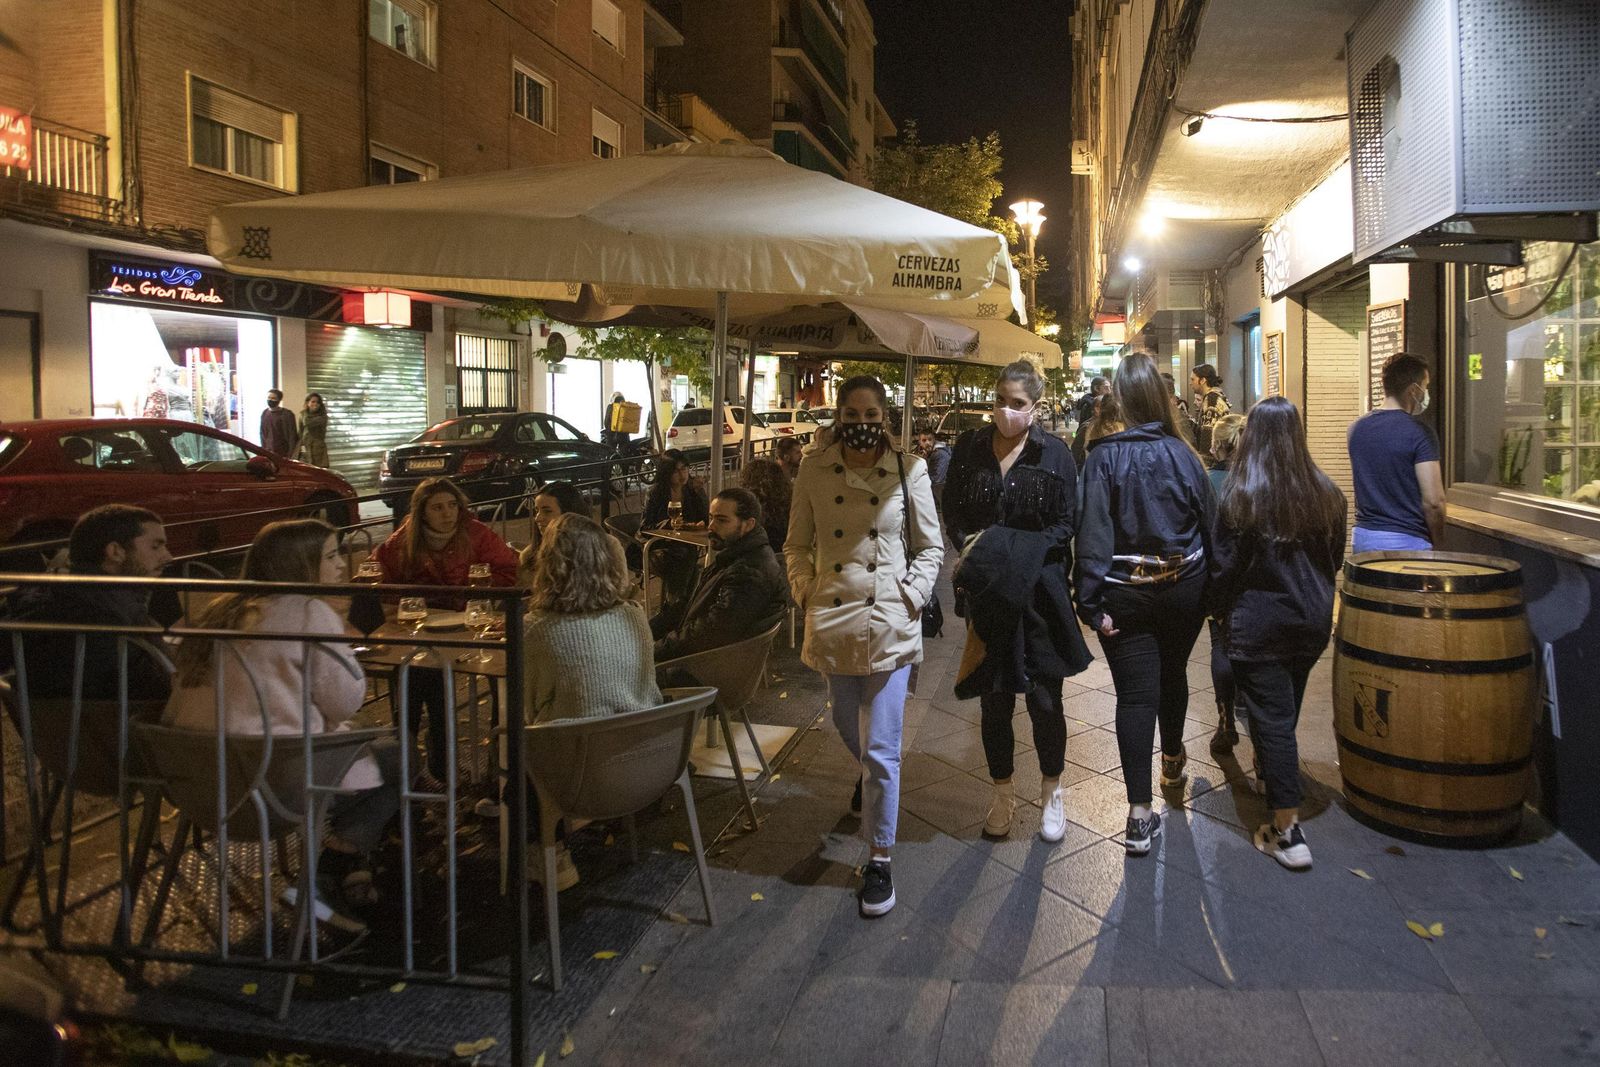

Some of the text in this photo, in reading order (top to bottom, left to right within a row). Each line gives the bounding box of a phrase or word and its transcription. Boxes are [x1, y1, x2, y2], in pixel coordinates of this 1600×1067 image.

[112, 266, 158, 279] TEJIDOS
[898, 255, 960, 273] CERVEZAS
[110, 276, 224, 304] La Gran Tienda
[892, 273, 962, 291] ALHAMBRA
